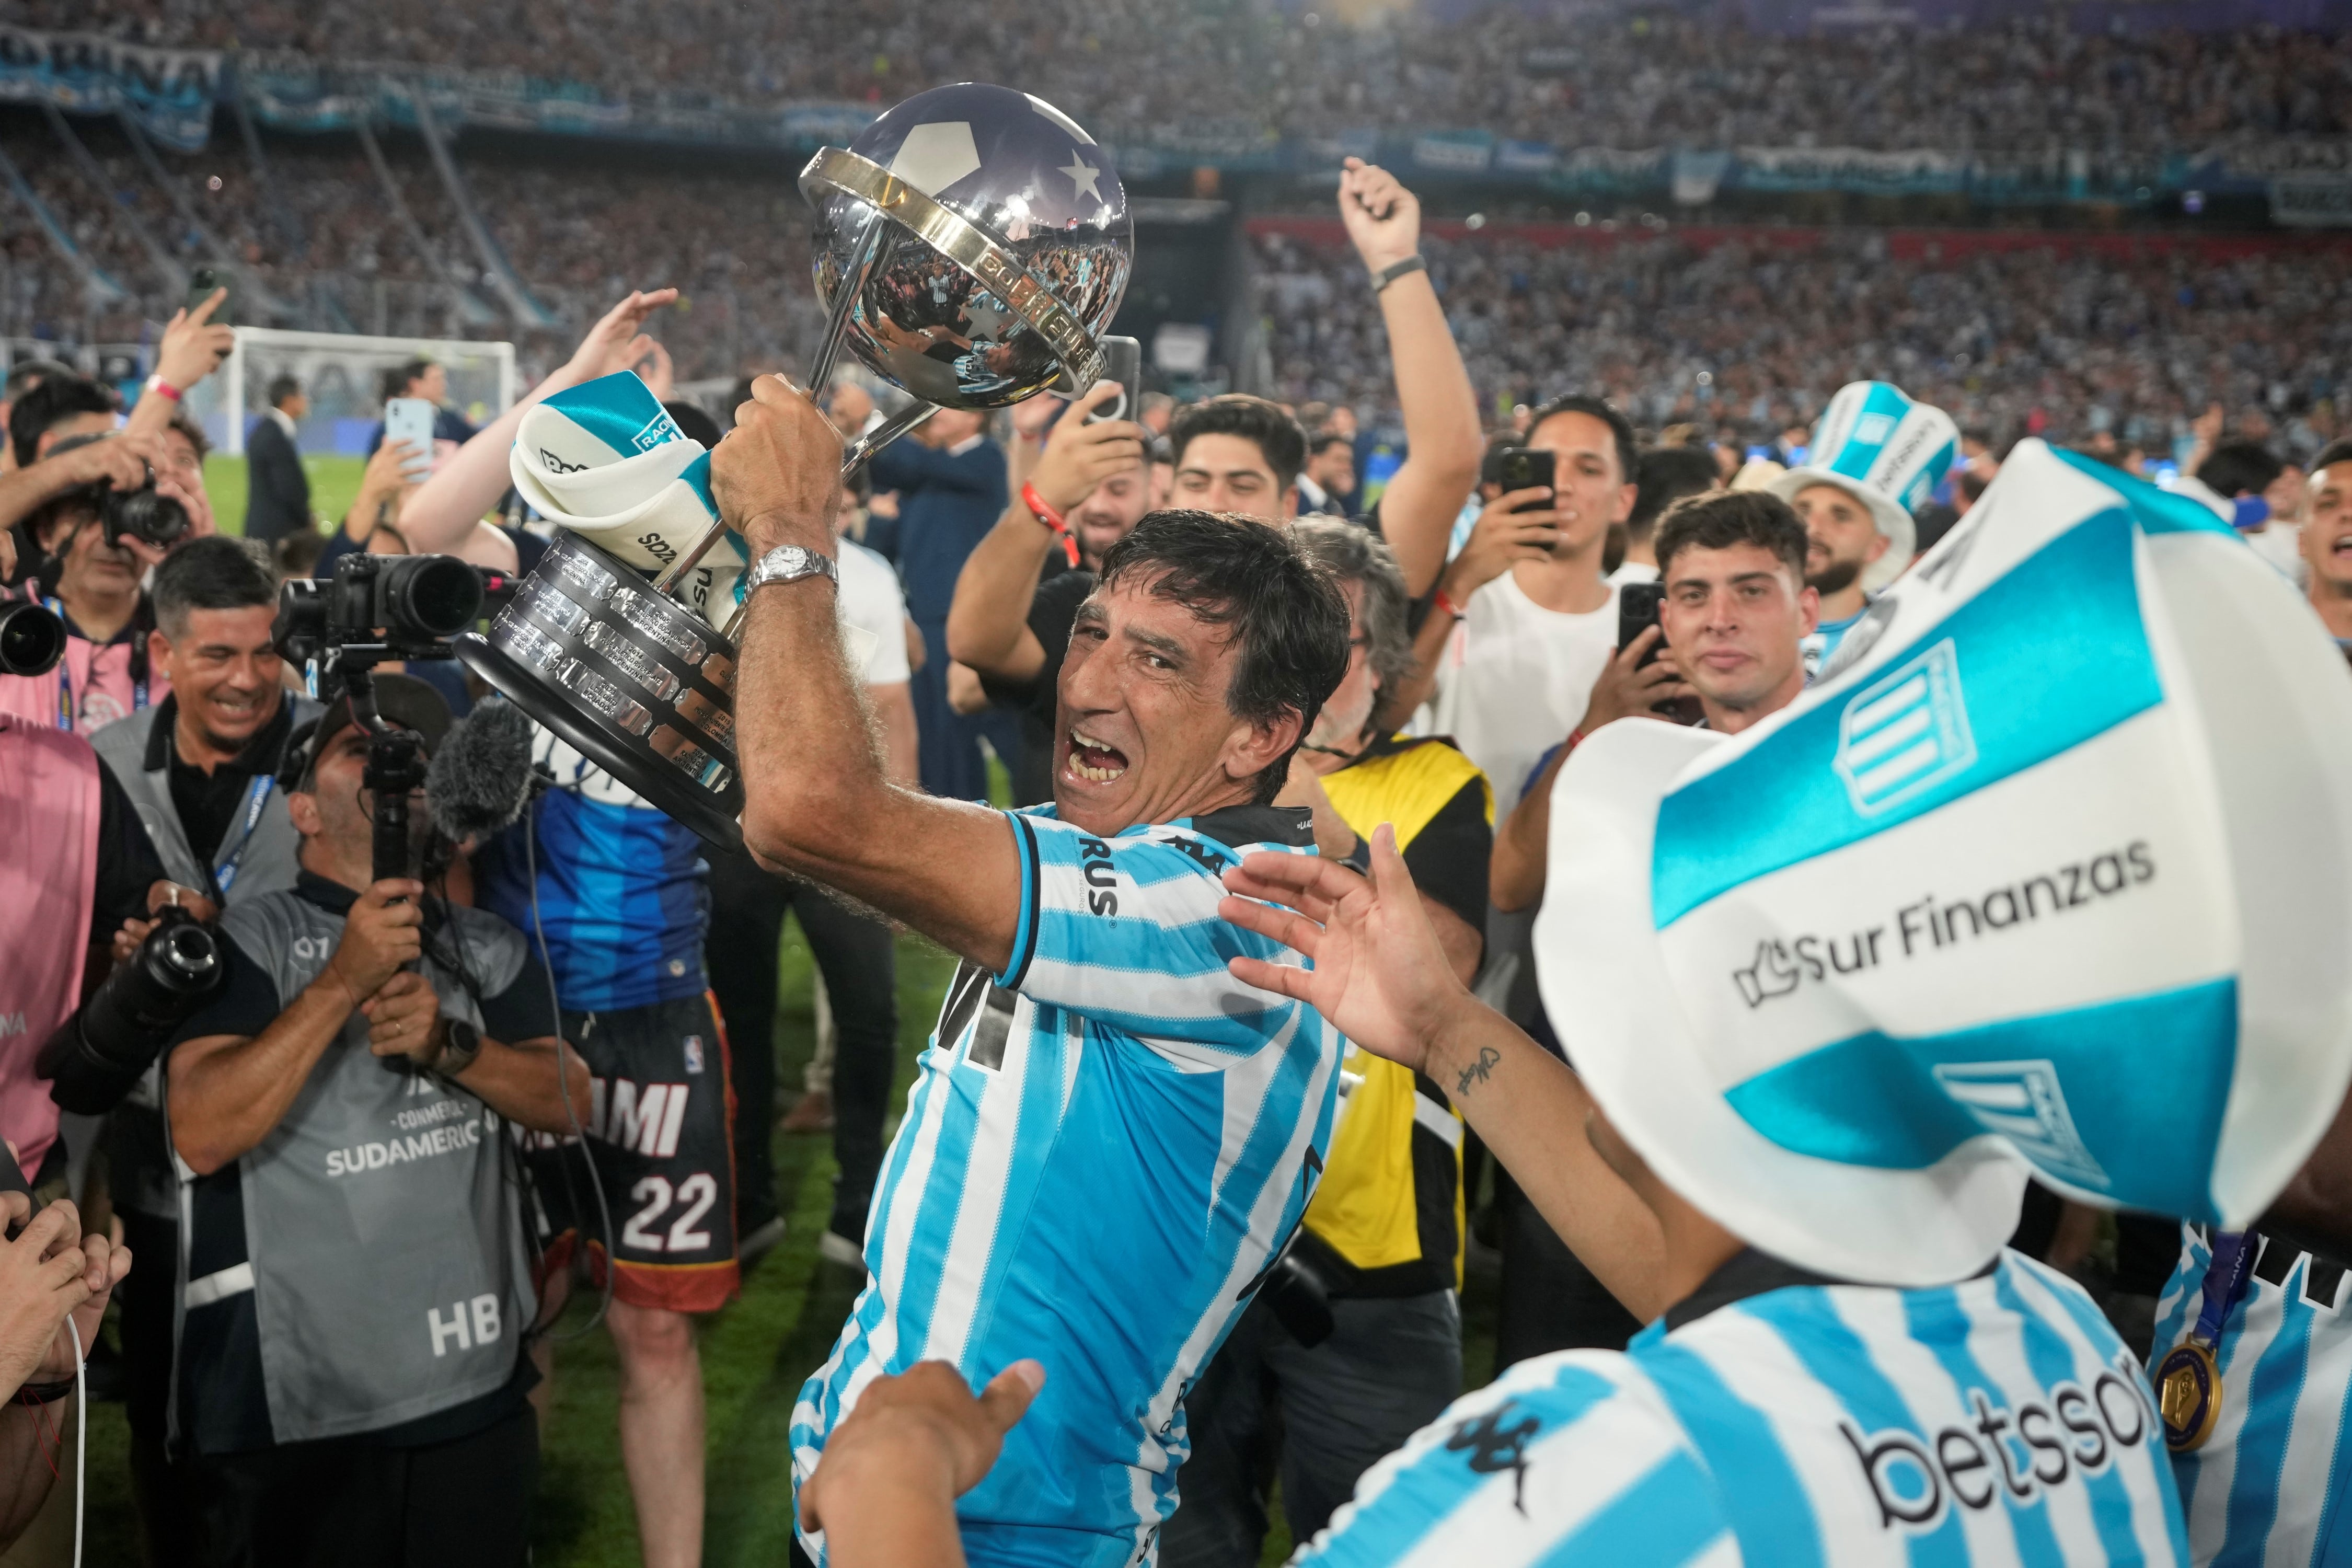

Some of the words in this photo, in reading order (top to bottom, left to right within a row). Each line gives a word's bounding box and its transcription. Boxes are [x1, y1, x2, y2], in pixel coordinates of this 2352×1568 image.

[980, 252, 1045, 315] COPA
[643, 416, 674, 448] RACIN
[562, 565, 586, 585] ARGENTINA
[654, 611, 671, 625] 2005
[634, 617, 671, 647] ARGENTINA
[658, 624, 671, 637] BOCA
[670, 633, 692, 651] JUNIORS
[628, 647, 643, 660] 2014
[607, 653, 643, 683] ARGENTINA
[633, 660, 648, 675] RIVER
[601, 682, 617, 696] 2023
[603, 693, 618, 707] QUITO
[582, 690, 615, 716] ECUADOR
[718, 714, 731, 725] 2015
[700, 722, 728, 744] COLOMBIA
[681, 750, 696, 764] RACING
[695, 760, 706, 770] CLUB
[693, 748, 706, 760] 2024
[673, 756, 704, 780] ARGENTINA
[1078, 837, 1118, 917] RUS
[1795, 925, 1885, 983] Sur
[1896, 837, 2157, 958] Finanzas
[397, 1101, 465, 1130] CONMEBOL
[326, 1113, 494, 1178] SUDAMERIC
[621, 1172, 719, 1252] 22
[427, 1293, 502, 1358] HB
